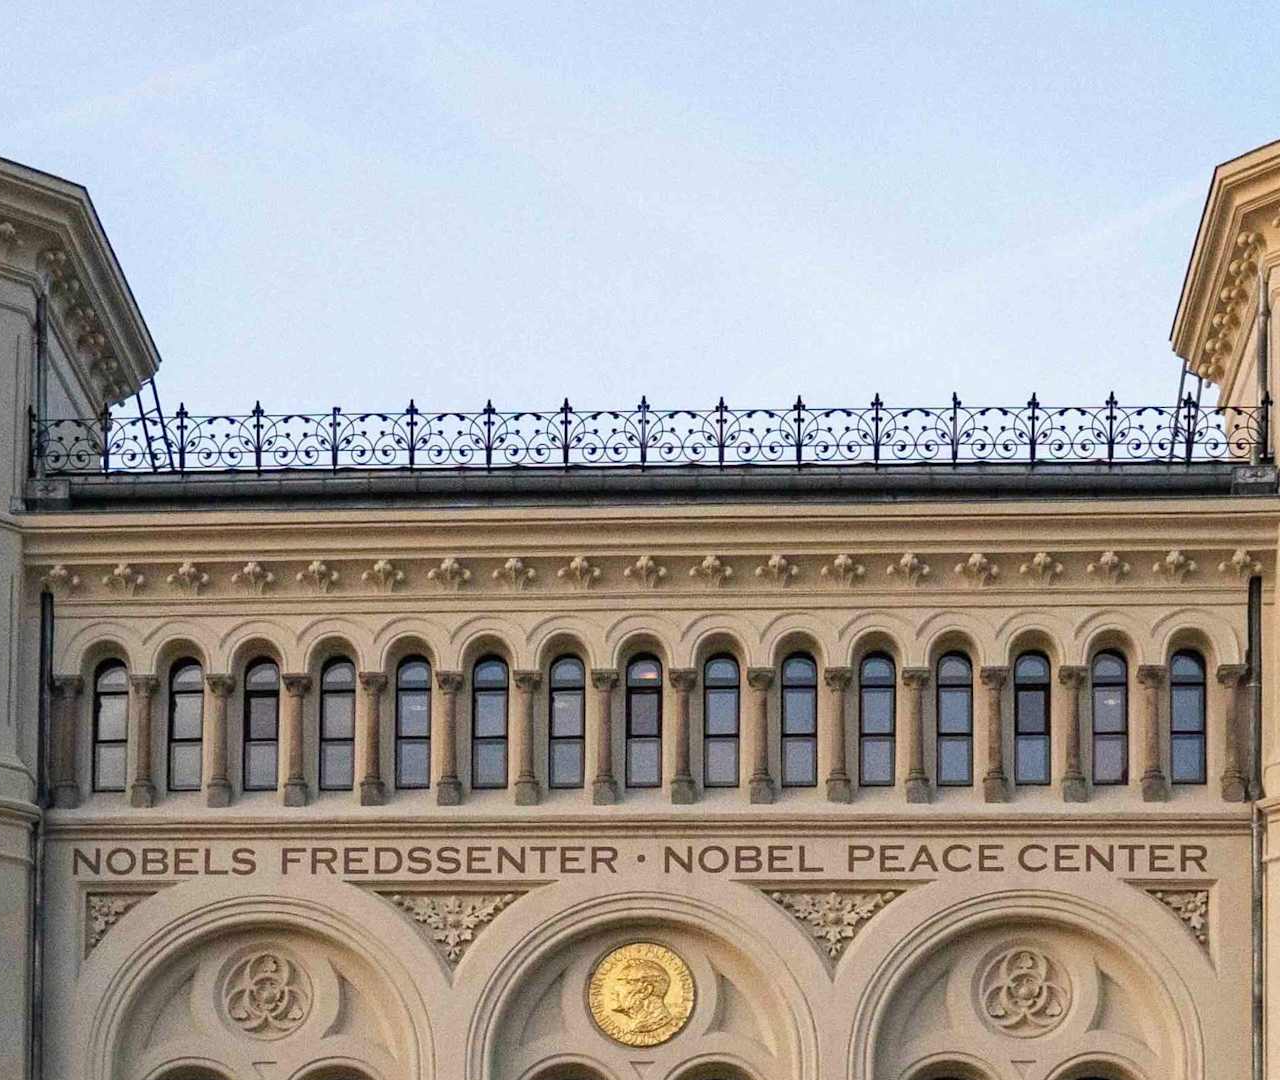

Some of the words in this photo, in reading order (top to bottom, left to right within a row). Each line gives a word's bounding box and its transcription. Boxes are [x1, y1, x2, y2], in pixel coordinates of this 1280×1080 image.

[72, 847, 257, 877] NOBELS
[280, 845, 619, 876] FREDSSENTER
[663, 844, 824, 874] NOBEL
[847, 843, 1005, 873] PEACE
[1017, 843, 1208, 873] CENTER
